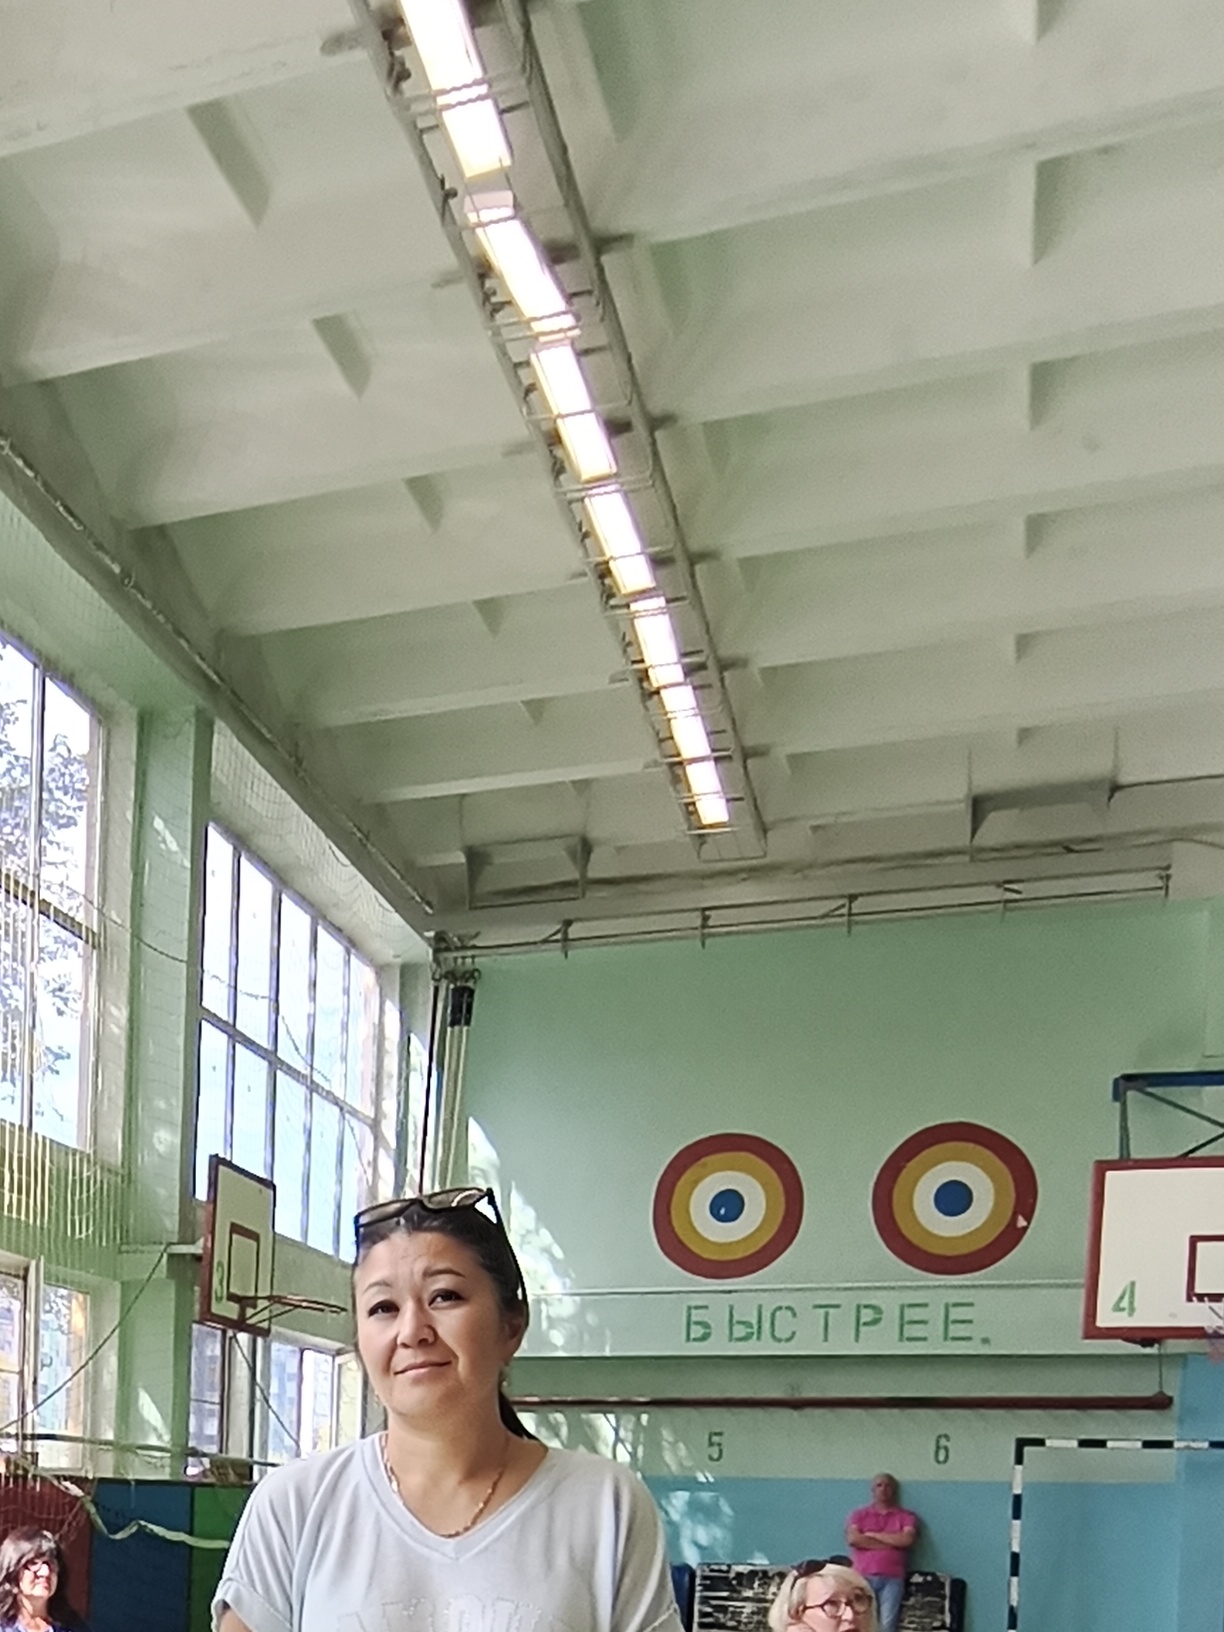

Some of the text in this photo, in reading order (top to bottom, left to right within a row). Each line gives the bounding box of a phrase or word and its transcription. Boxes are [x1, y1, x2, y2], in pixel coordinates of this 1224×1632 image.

[215, 1259, 224, 1304] 3
[1111, 1280, 1136, 1318] 4
[685, 1302, 991, 1344] БЫСТРЕЕ.
[707, 1431, 724, 1462] 5
[934, 1433, 950, 1465] 6
